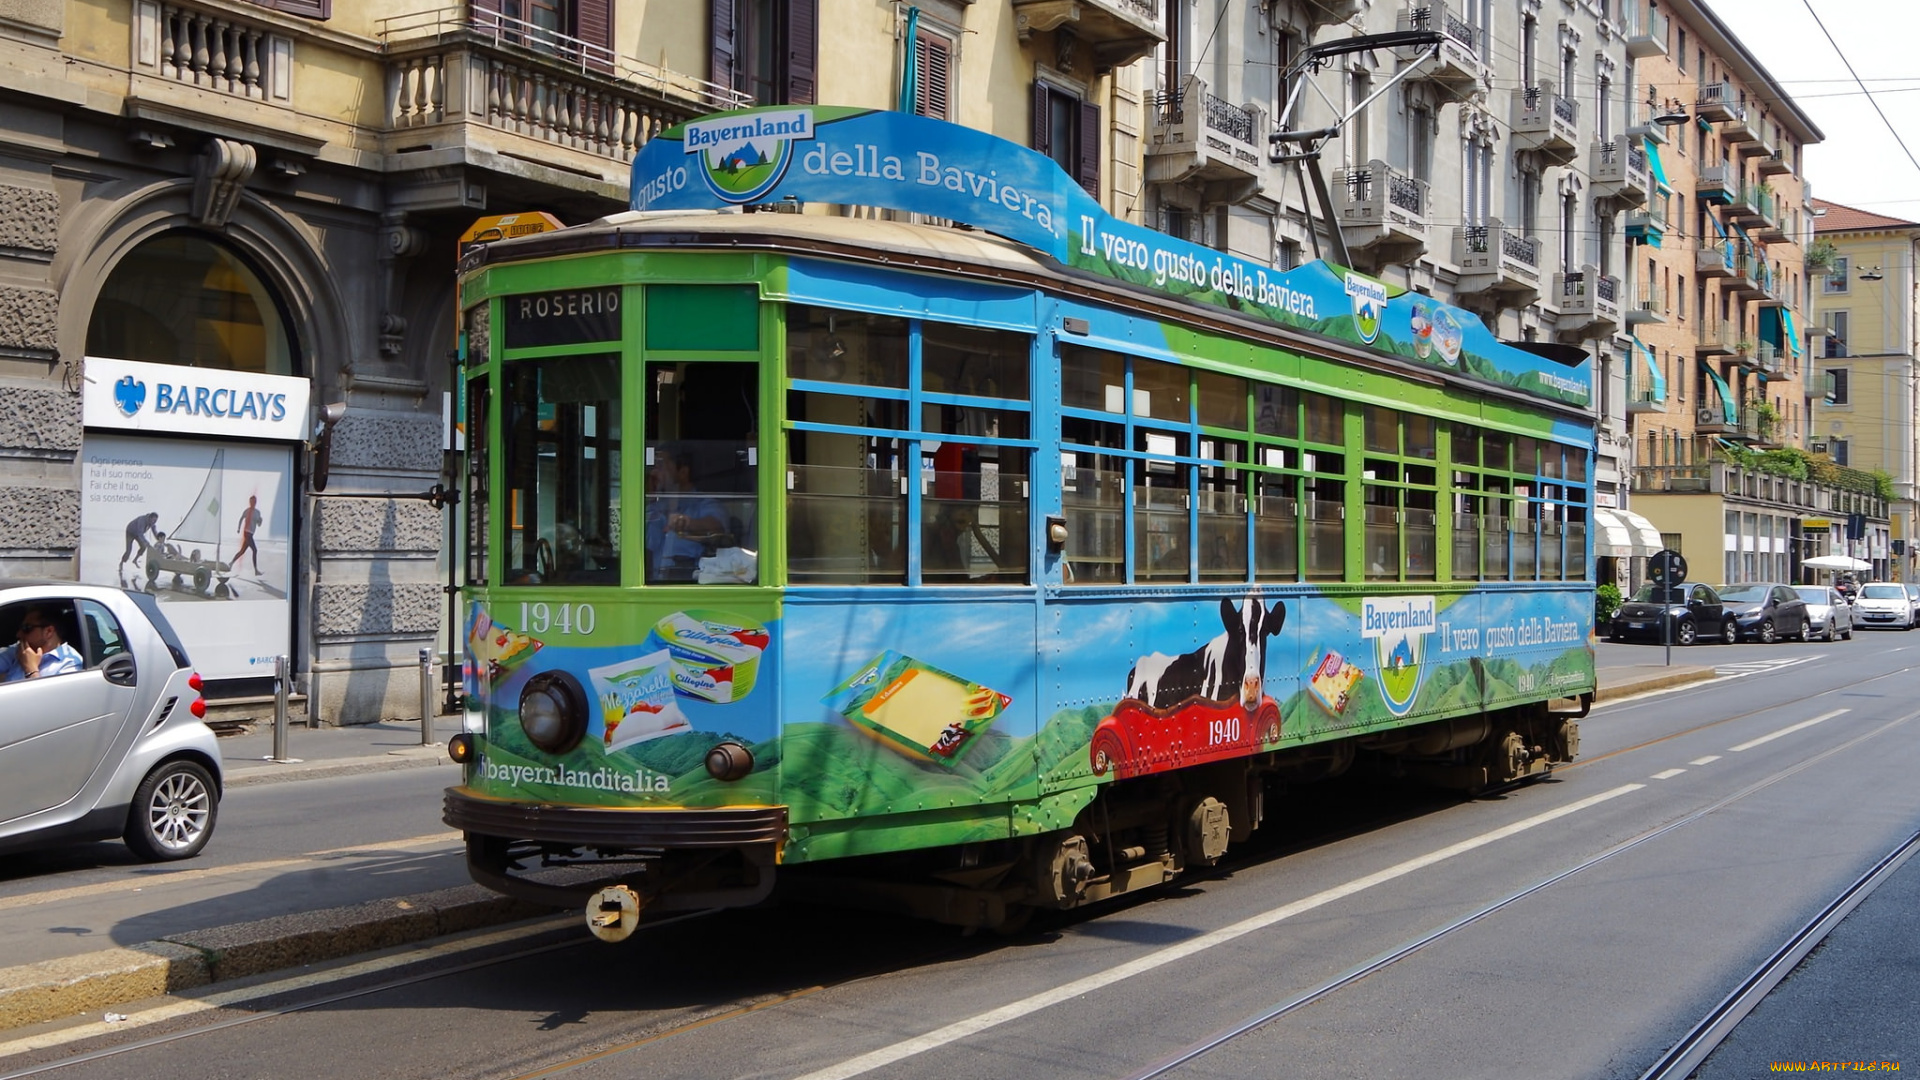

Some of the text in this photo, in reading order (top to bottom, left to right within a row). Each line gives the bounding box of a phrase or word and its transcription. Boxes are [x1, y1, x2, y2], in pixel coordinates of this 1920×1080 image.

[688, 114, 806, 147] Bayernland
[638, 142, 1059, 239] gusto della Baviera.
[1080, 215, 1319, 320] Il vero gusto della Baviera.
[1347, 276, 1385, 302] Bayernland
[520, 291, 619, 319] ROSERIO
[1538, 371, 1587, 396] www.bayernland.it
[154, 383, 286, 422] BARCLAYS
[90, 455, 143, 468] Ogni persona
[90, 468, 100, 478] ha
[102, 468, 107, 477] il
[108, 470, 123, 478] suo
[90, 480, 139, 491] Fai che il tuo
[90, 493, 101, 502] sia
[520, 602, 595, 635] 1940
[1365, 601, 1433, 636] Bayernland
[1441, 616, 1581, 656] Il vero gusto della Baviera.
[602, 675, 671, 710] Mozzarella
[1518, 673, 1535, 693] 1940
[1209, 717, 1240, 746] 1940
